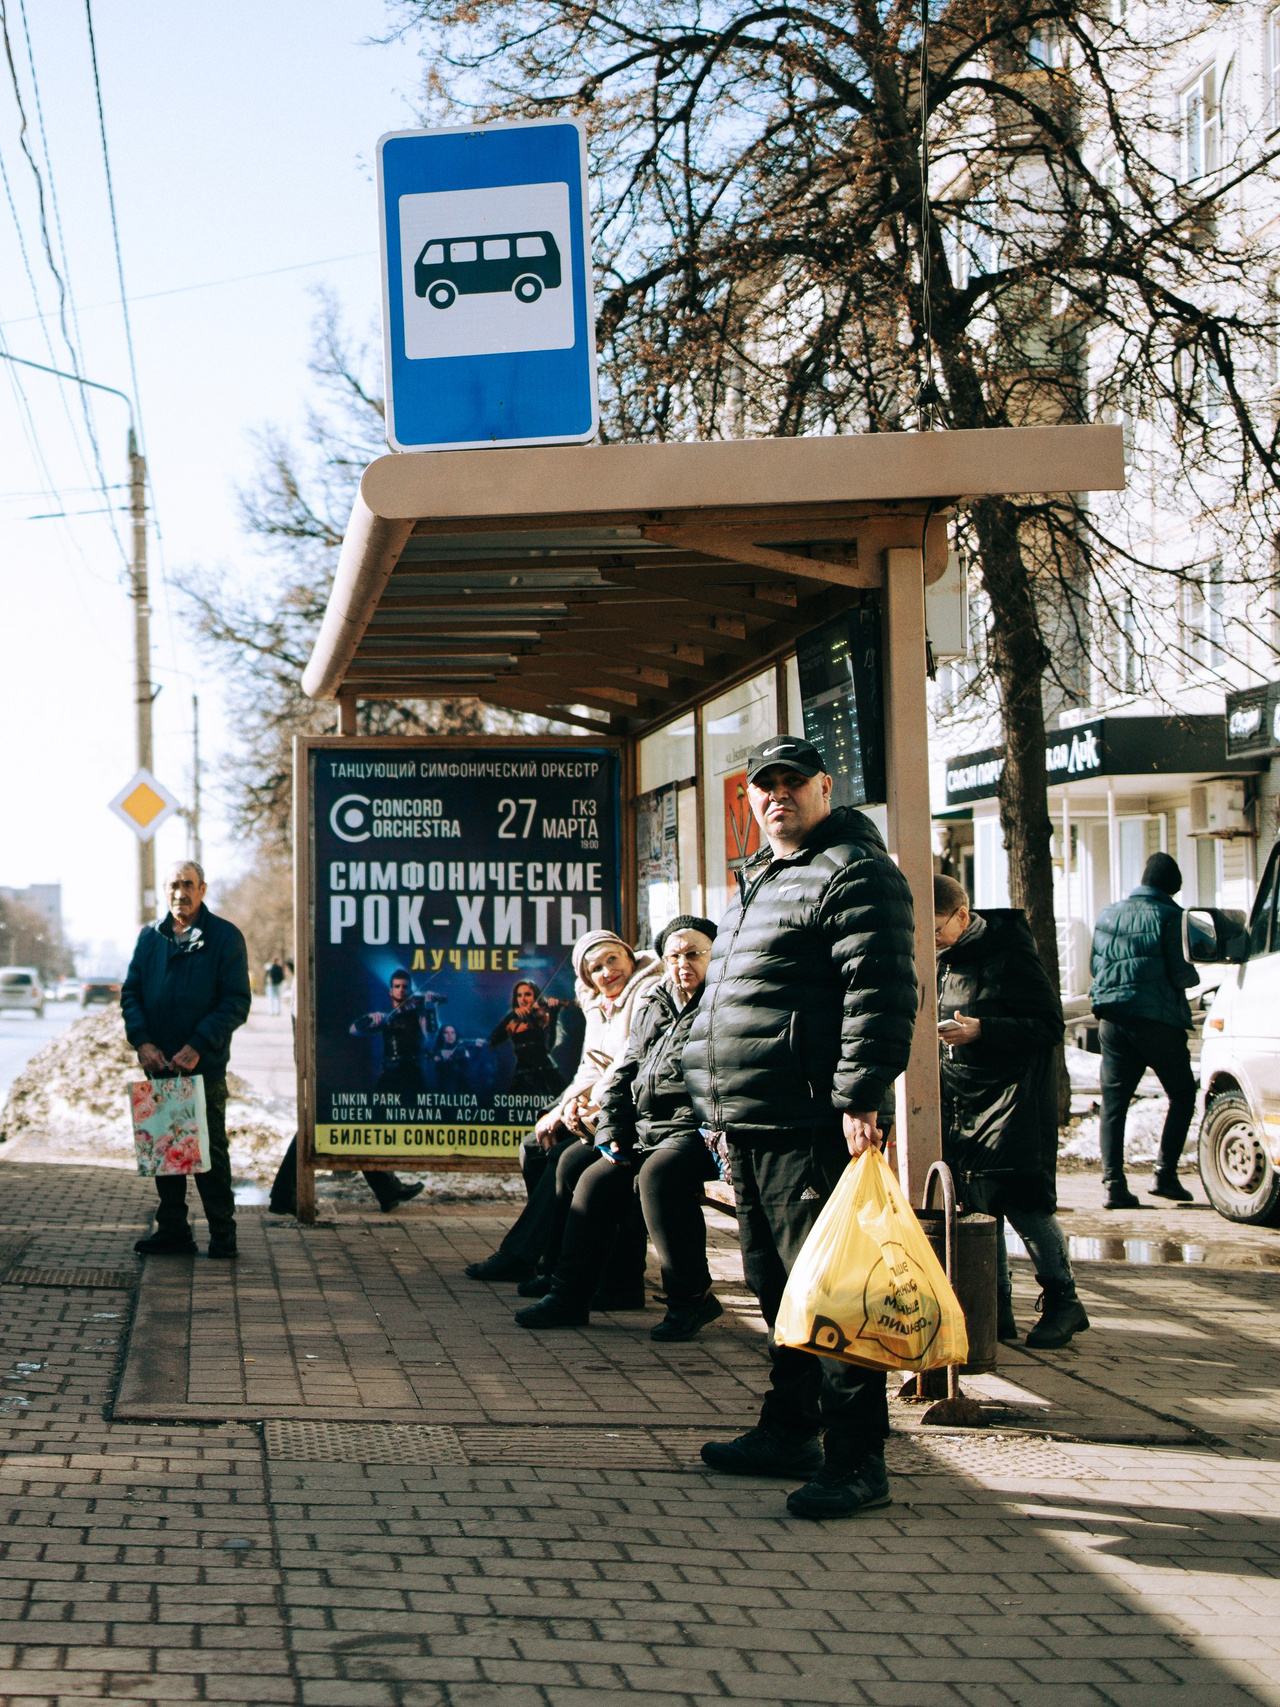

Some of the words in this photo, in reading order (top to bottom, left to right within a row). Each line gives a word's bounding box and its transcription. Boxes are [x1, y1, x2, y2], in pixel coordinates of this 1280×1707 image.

[330, 761, 416, 779] ТАНЦУЮЩИЙ
[420, 761, 537, 778] СИМФОНИЧЕСКИЙ
[541, 763, 598, 778] ОРКЕСТР
[372, 798, 443, 818] CONCORD
[572, 799, 597, 816] ГКЗ
[498, 799, 537, 838] 27
[543, 818, 598, 838] МАРТА
[372, 819, 461, 838] ORCHESTRA
[581, 840, 598, 849] 19:00
[330, 861, 602, 891] СИМФОНИЧЕСКИЕ
[330, 895, 602, 945] РОК-ХИТЫ
[411, 949, 521, 971] ЛУЧШЕЕ
[332, 1093, 367, 1106] LINKIN
[373, 1093, 401, 1106] PARK
[417, 1094, 477, 1107] METALLICA
[332, 1108, 372, 1121] QUEEN
[386, 1109, 442, 1121] NIRVANA
[457, 1109, 495, 1122] AC/DC
[330, 1129, 396, 1145] БИЛЕТЫ
